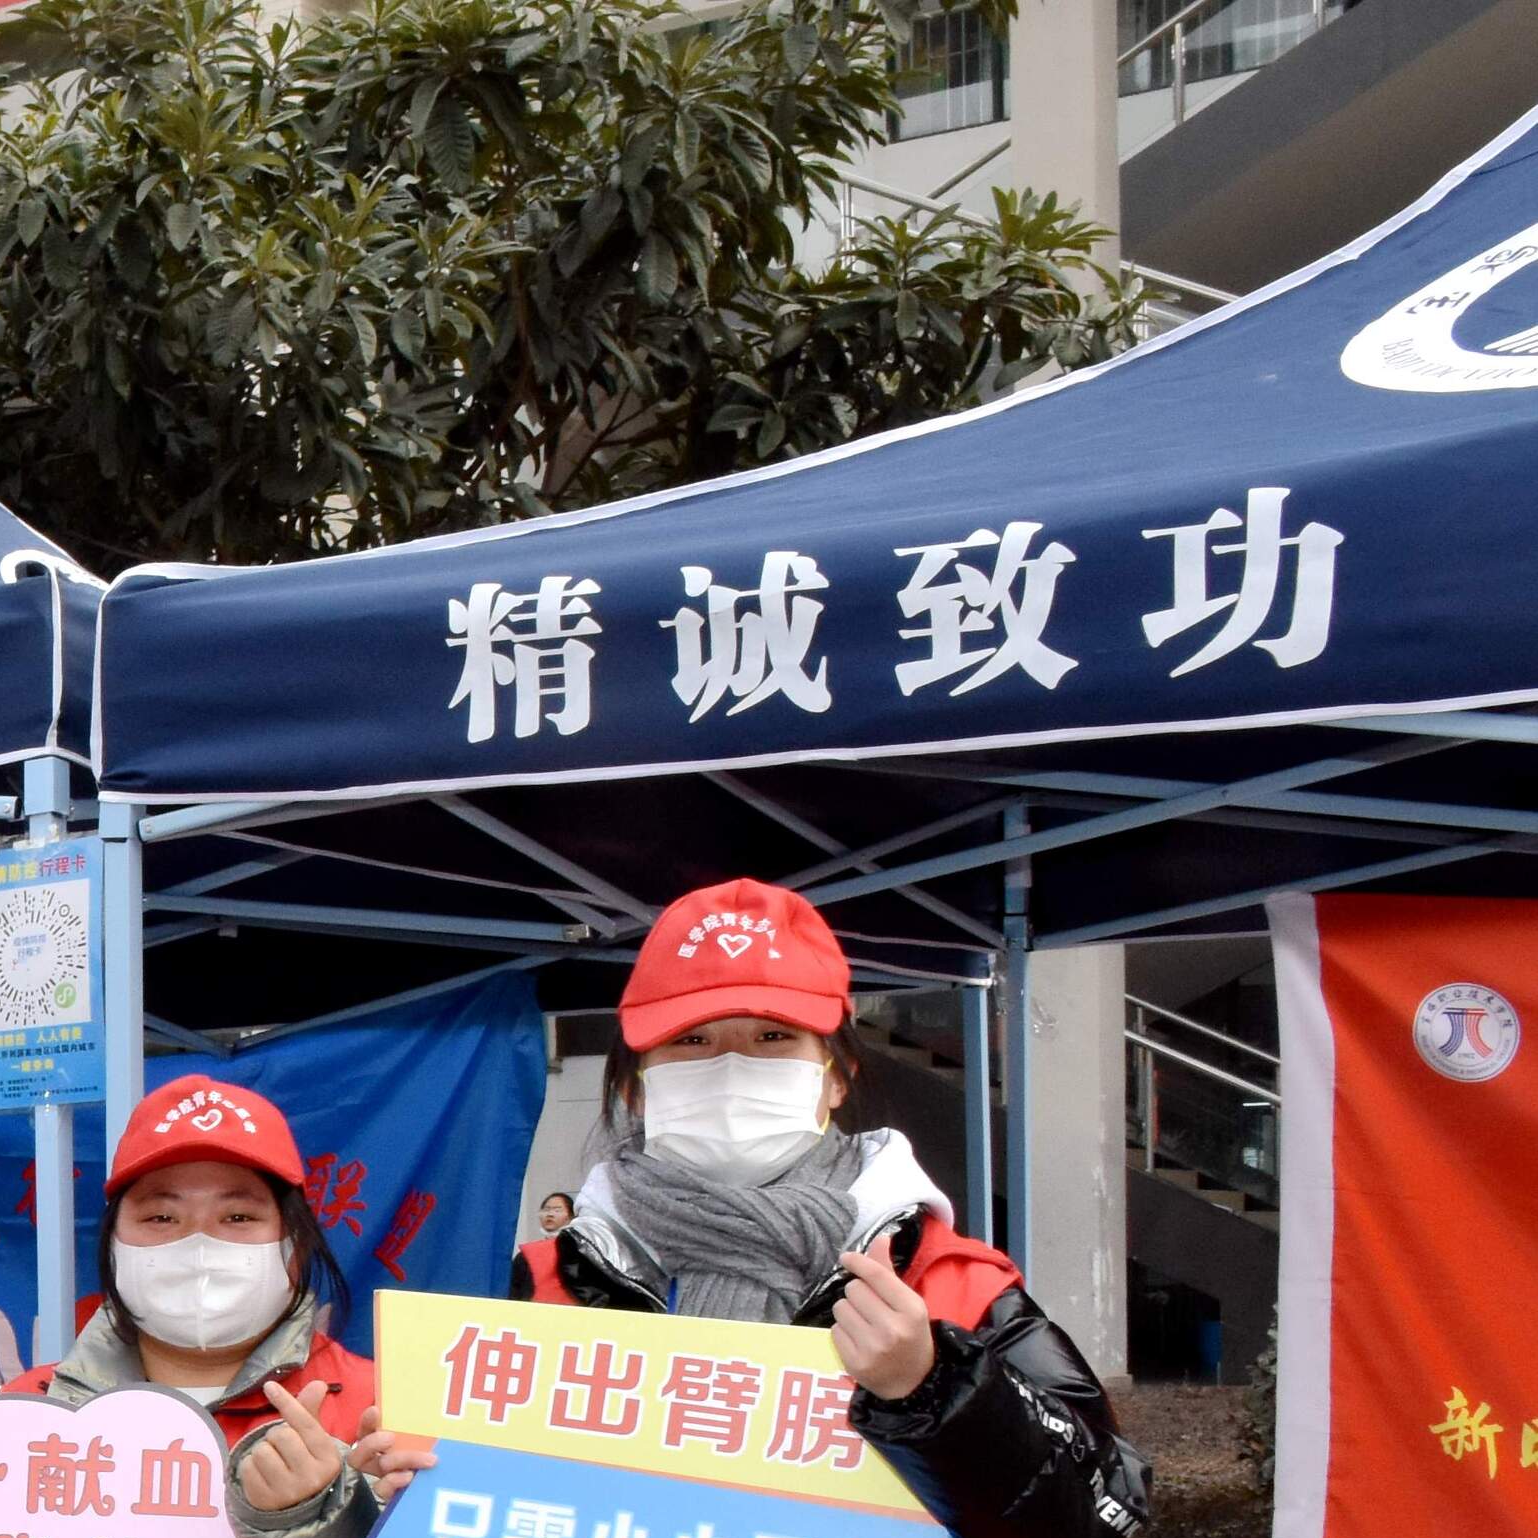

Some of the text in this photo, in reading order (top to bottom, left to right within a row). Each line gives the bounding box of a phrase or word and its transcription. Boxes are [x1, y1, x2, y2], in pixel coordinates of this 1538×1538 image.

[446, 487, 1346, 744] 精诚致功
[442, 1322, 866, 1471] 伸出臂膀
